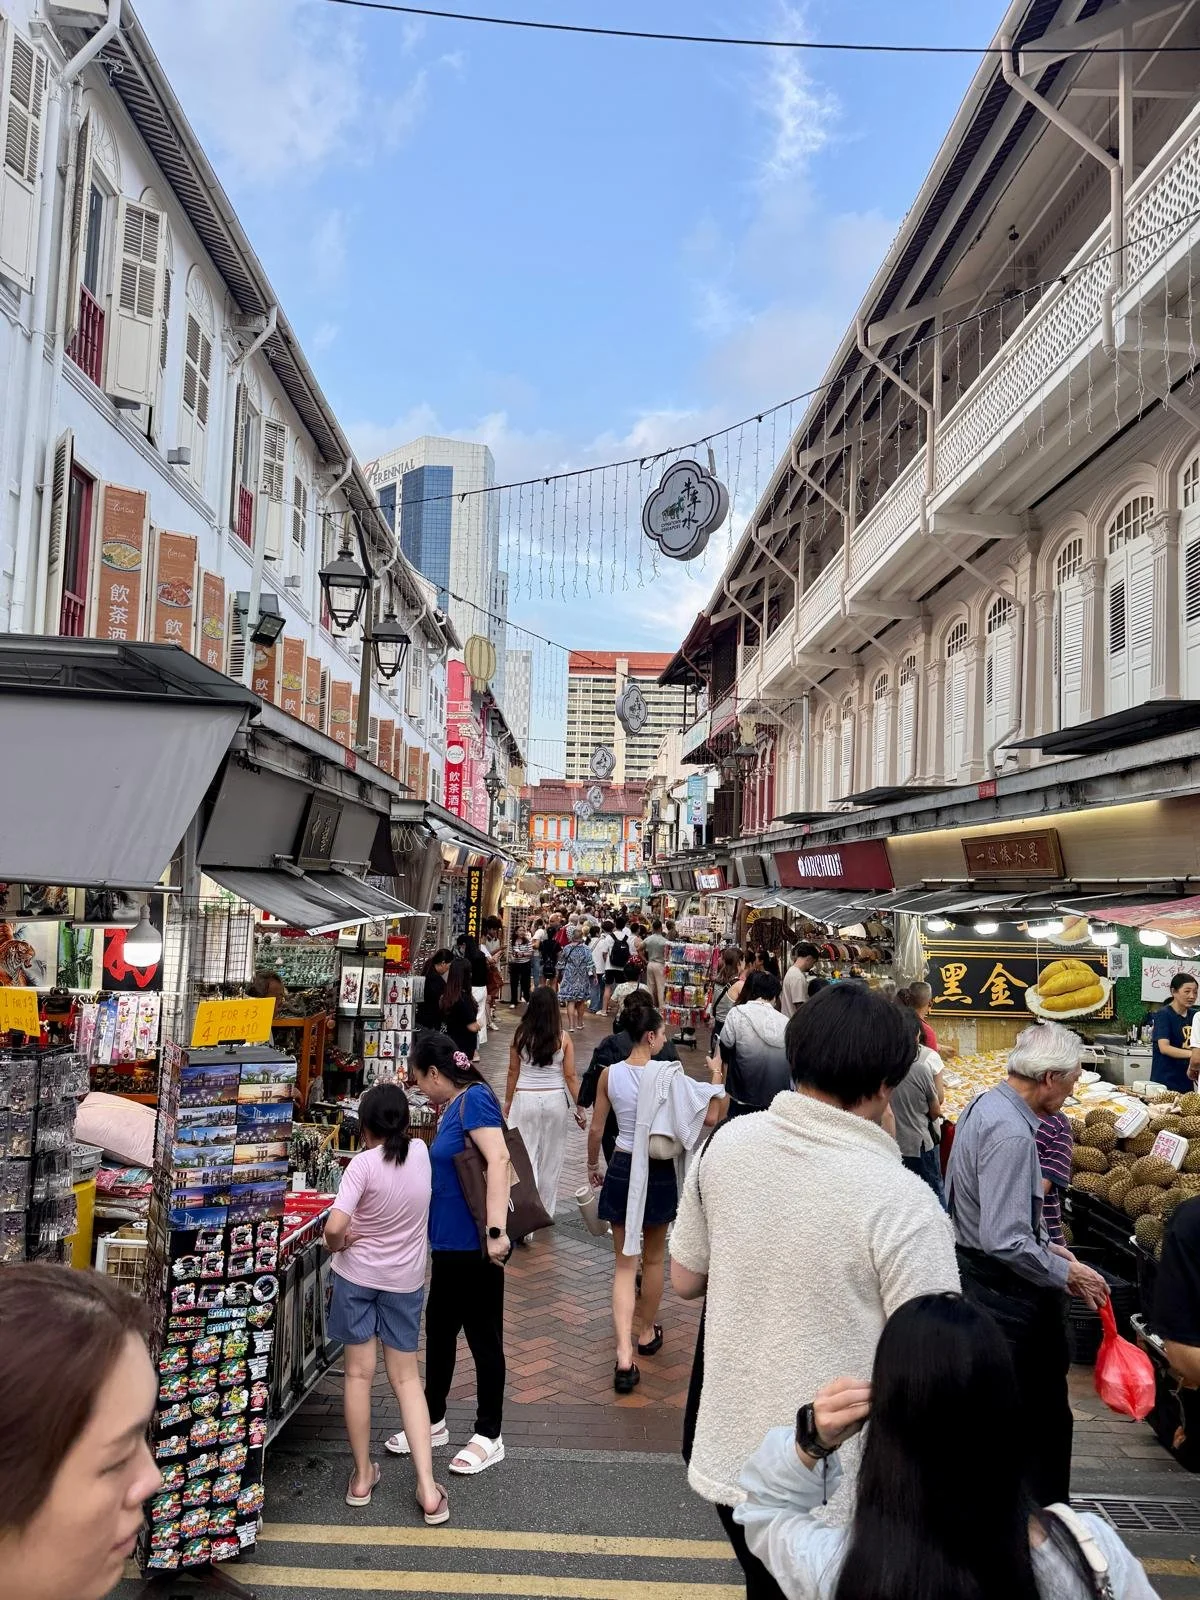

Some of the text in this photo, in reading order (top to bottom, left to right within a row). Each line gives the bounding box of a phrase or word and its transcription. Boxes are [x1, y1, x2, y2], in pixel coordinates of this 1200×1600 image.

[364, 458, 416, 485] PERENNIAL
[469, 870, 480, 903] MONEY
[932, 962, 1028, 1007] 黑金
[221, 1008, 239, 1021] FOR
[243, 1005, 259, 1020] $3
[202, 1026, 212, 1042] 4
[217, 1025, 237, 1039] FOR
